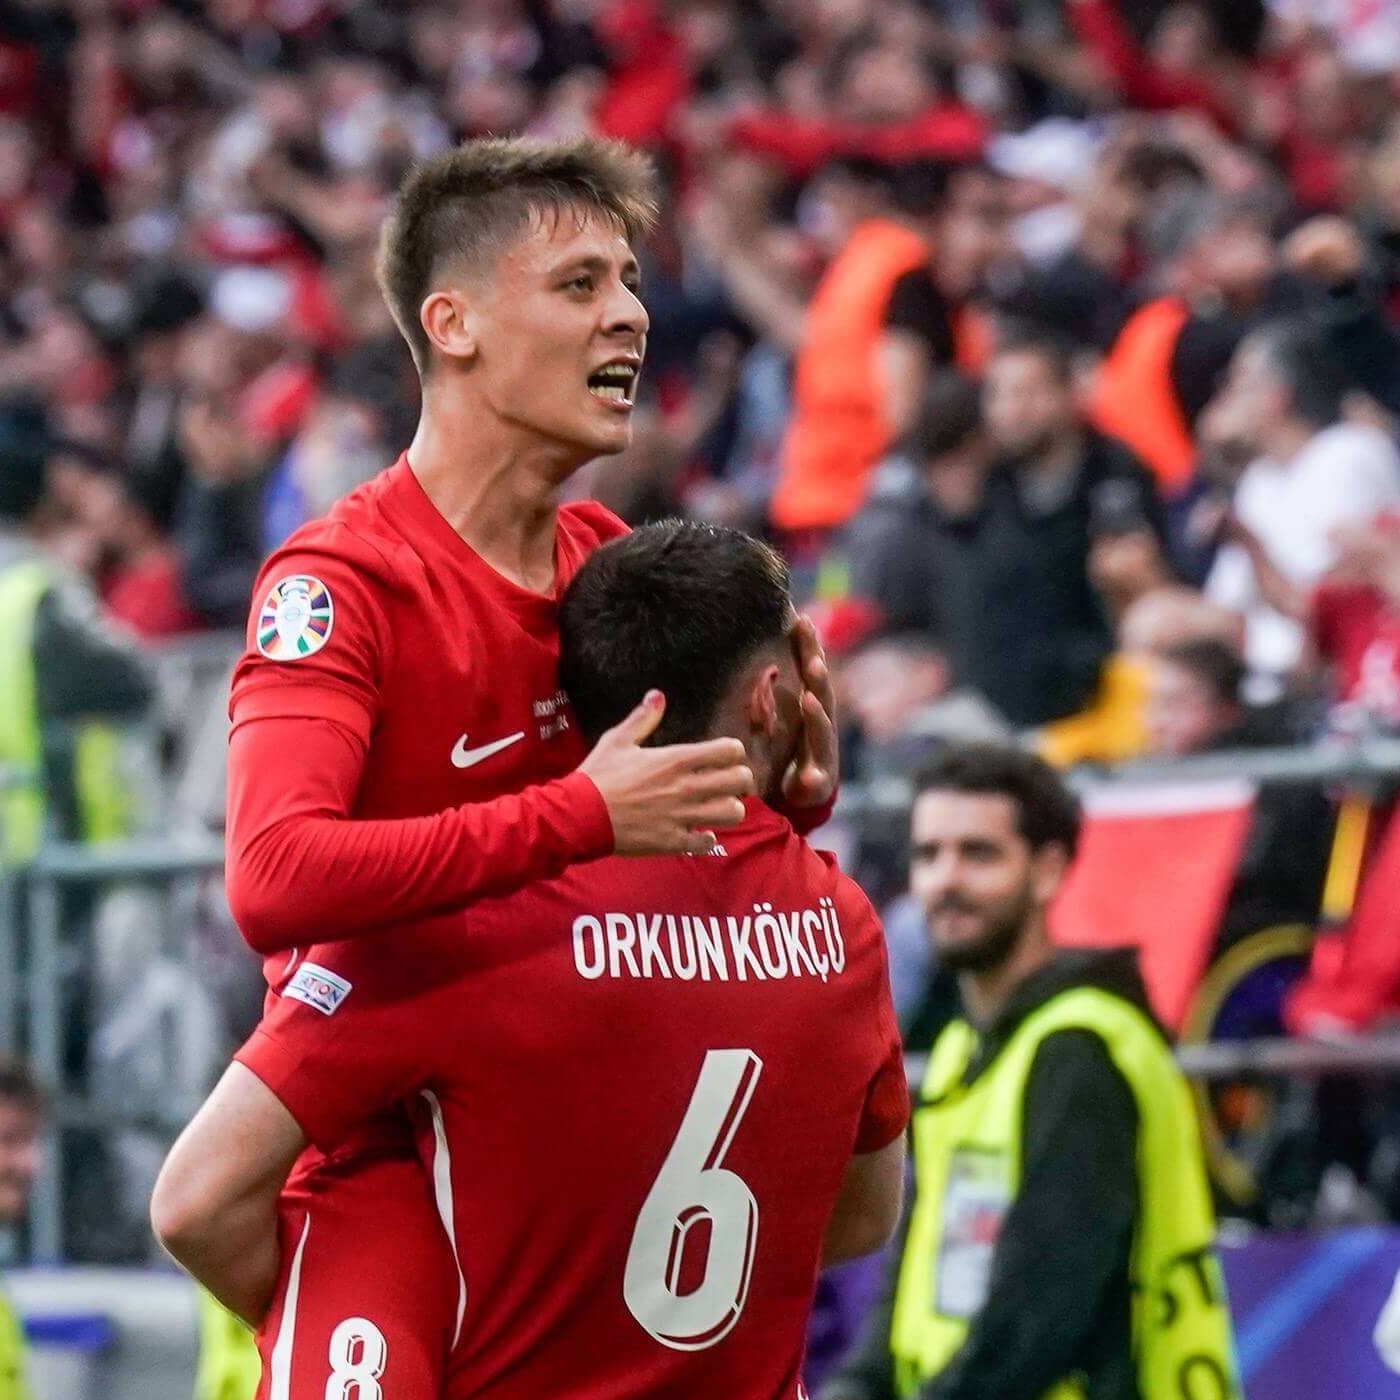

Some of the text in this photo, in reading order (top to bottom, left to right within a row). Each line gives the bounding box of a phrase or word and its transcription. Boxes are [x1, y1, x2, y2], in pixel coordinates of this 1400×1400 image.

[572, 896, 846, 984] ORKUN KÖKÇÜ
[623, 1048, 764, 1352] 6
